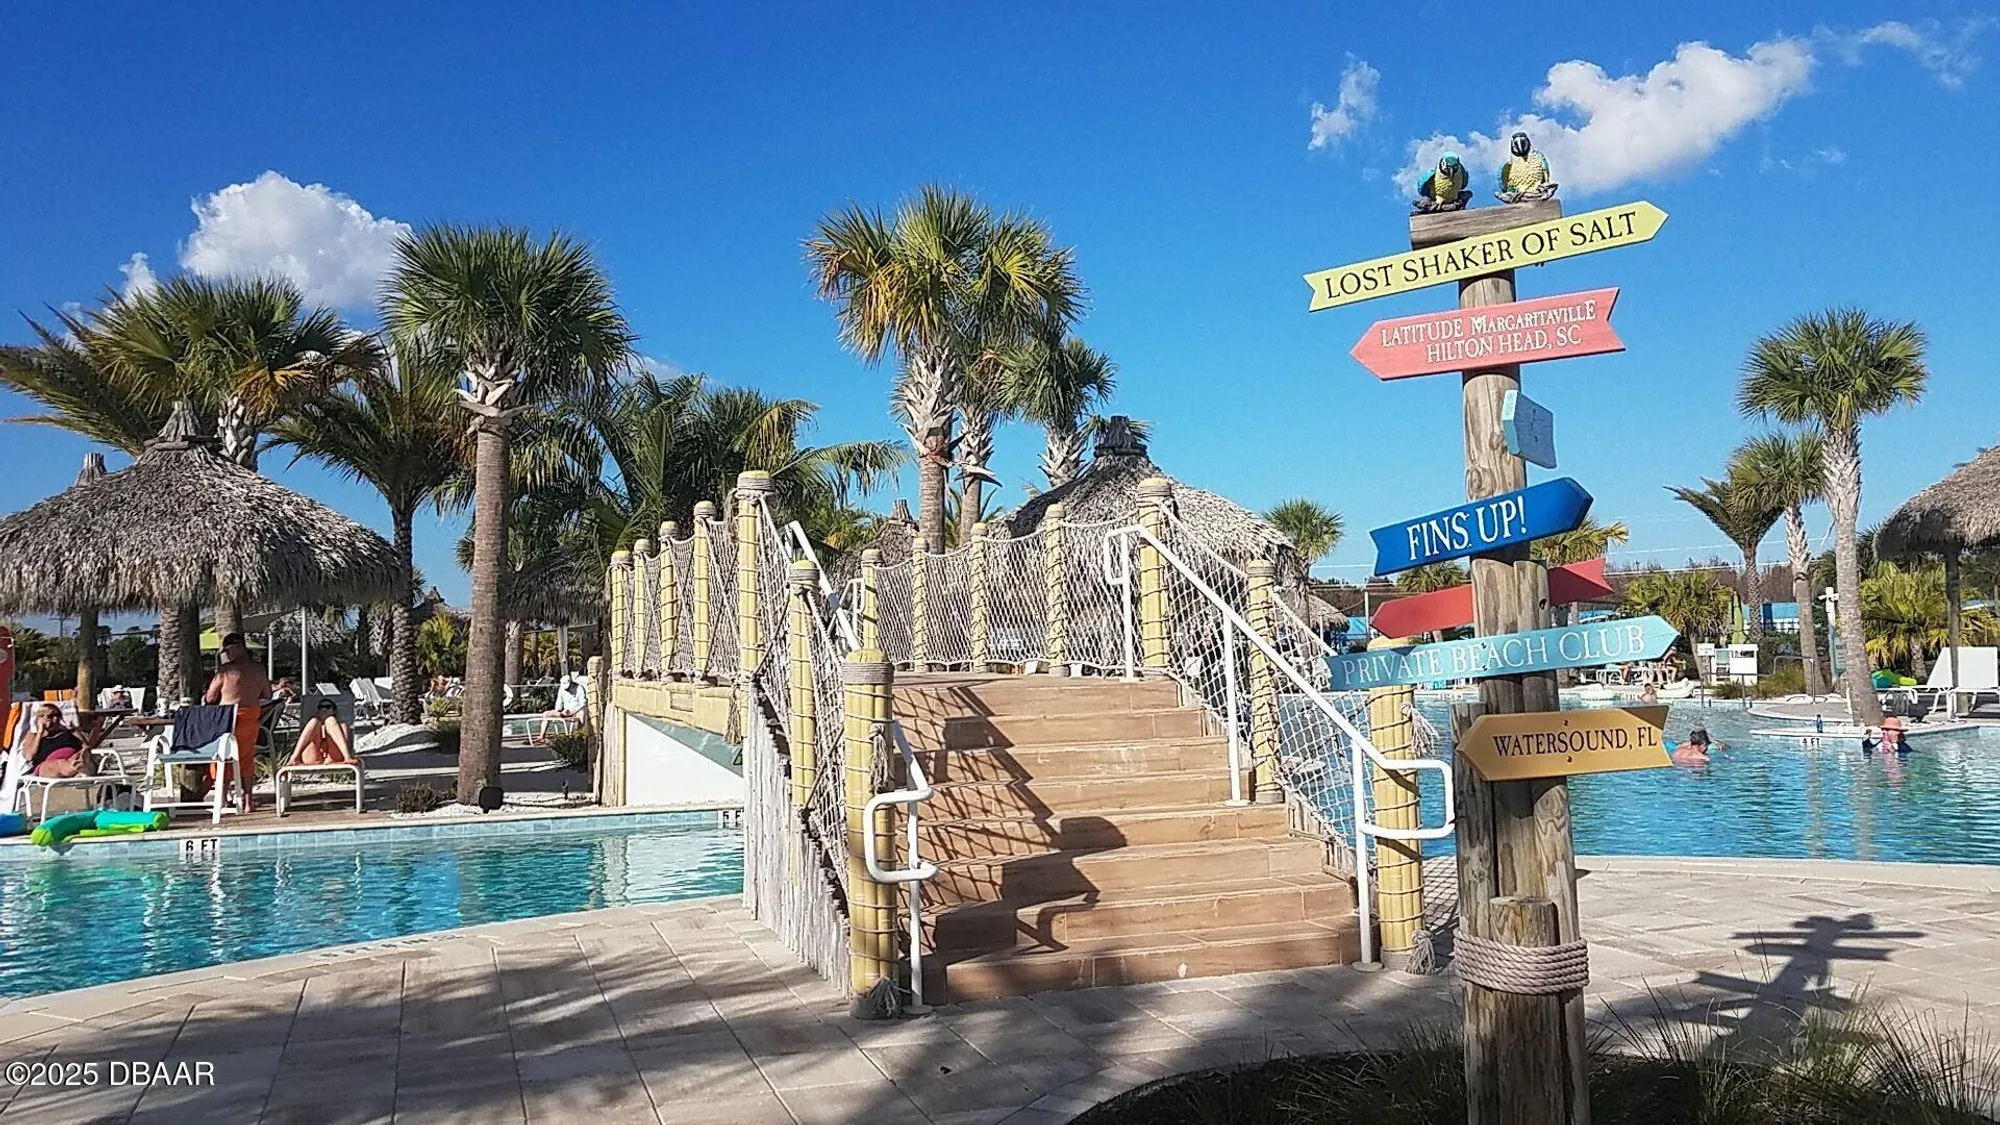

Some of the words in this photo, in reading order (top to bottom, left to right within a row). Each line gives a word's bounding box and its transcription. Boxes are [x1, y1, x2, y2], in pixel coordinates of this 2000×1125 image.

[1325, 264, 1394, 300] LOST
[1404, 238, 1514, 282] SHAKER
[1522, 228, 1560, 255] OF
[1571, 211, 1637, 247] SALT
[1381, 318, 1463, 347] LATITUDE
[1427, 335, 1493, 364] HILTON
[1499, 329, 1553, 354] HEAD,
[1556, 325, 1582, 345] SC
[1407, 512, 1470, 561] FINS
[1478, 497, 1527, 543] UP!
[1343, 645, 1444, 684] PRIVATE
[1452, 636, 1547, 673] BEACH
[1559, 625, 1645, 662] CLUB
[1493, 728, 1633, 758] WATERSOUND,
[1637, 727, 1657, 748] FL
[186, 839, 194, 851] 6
[201, 838, 217, 851] FT
